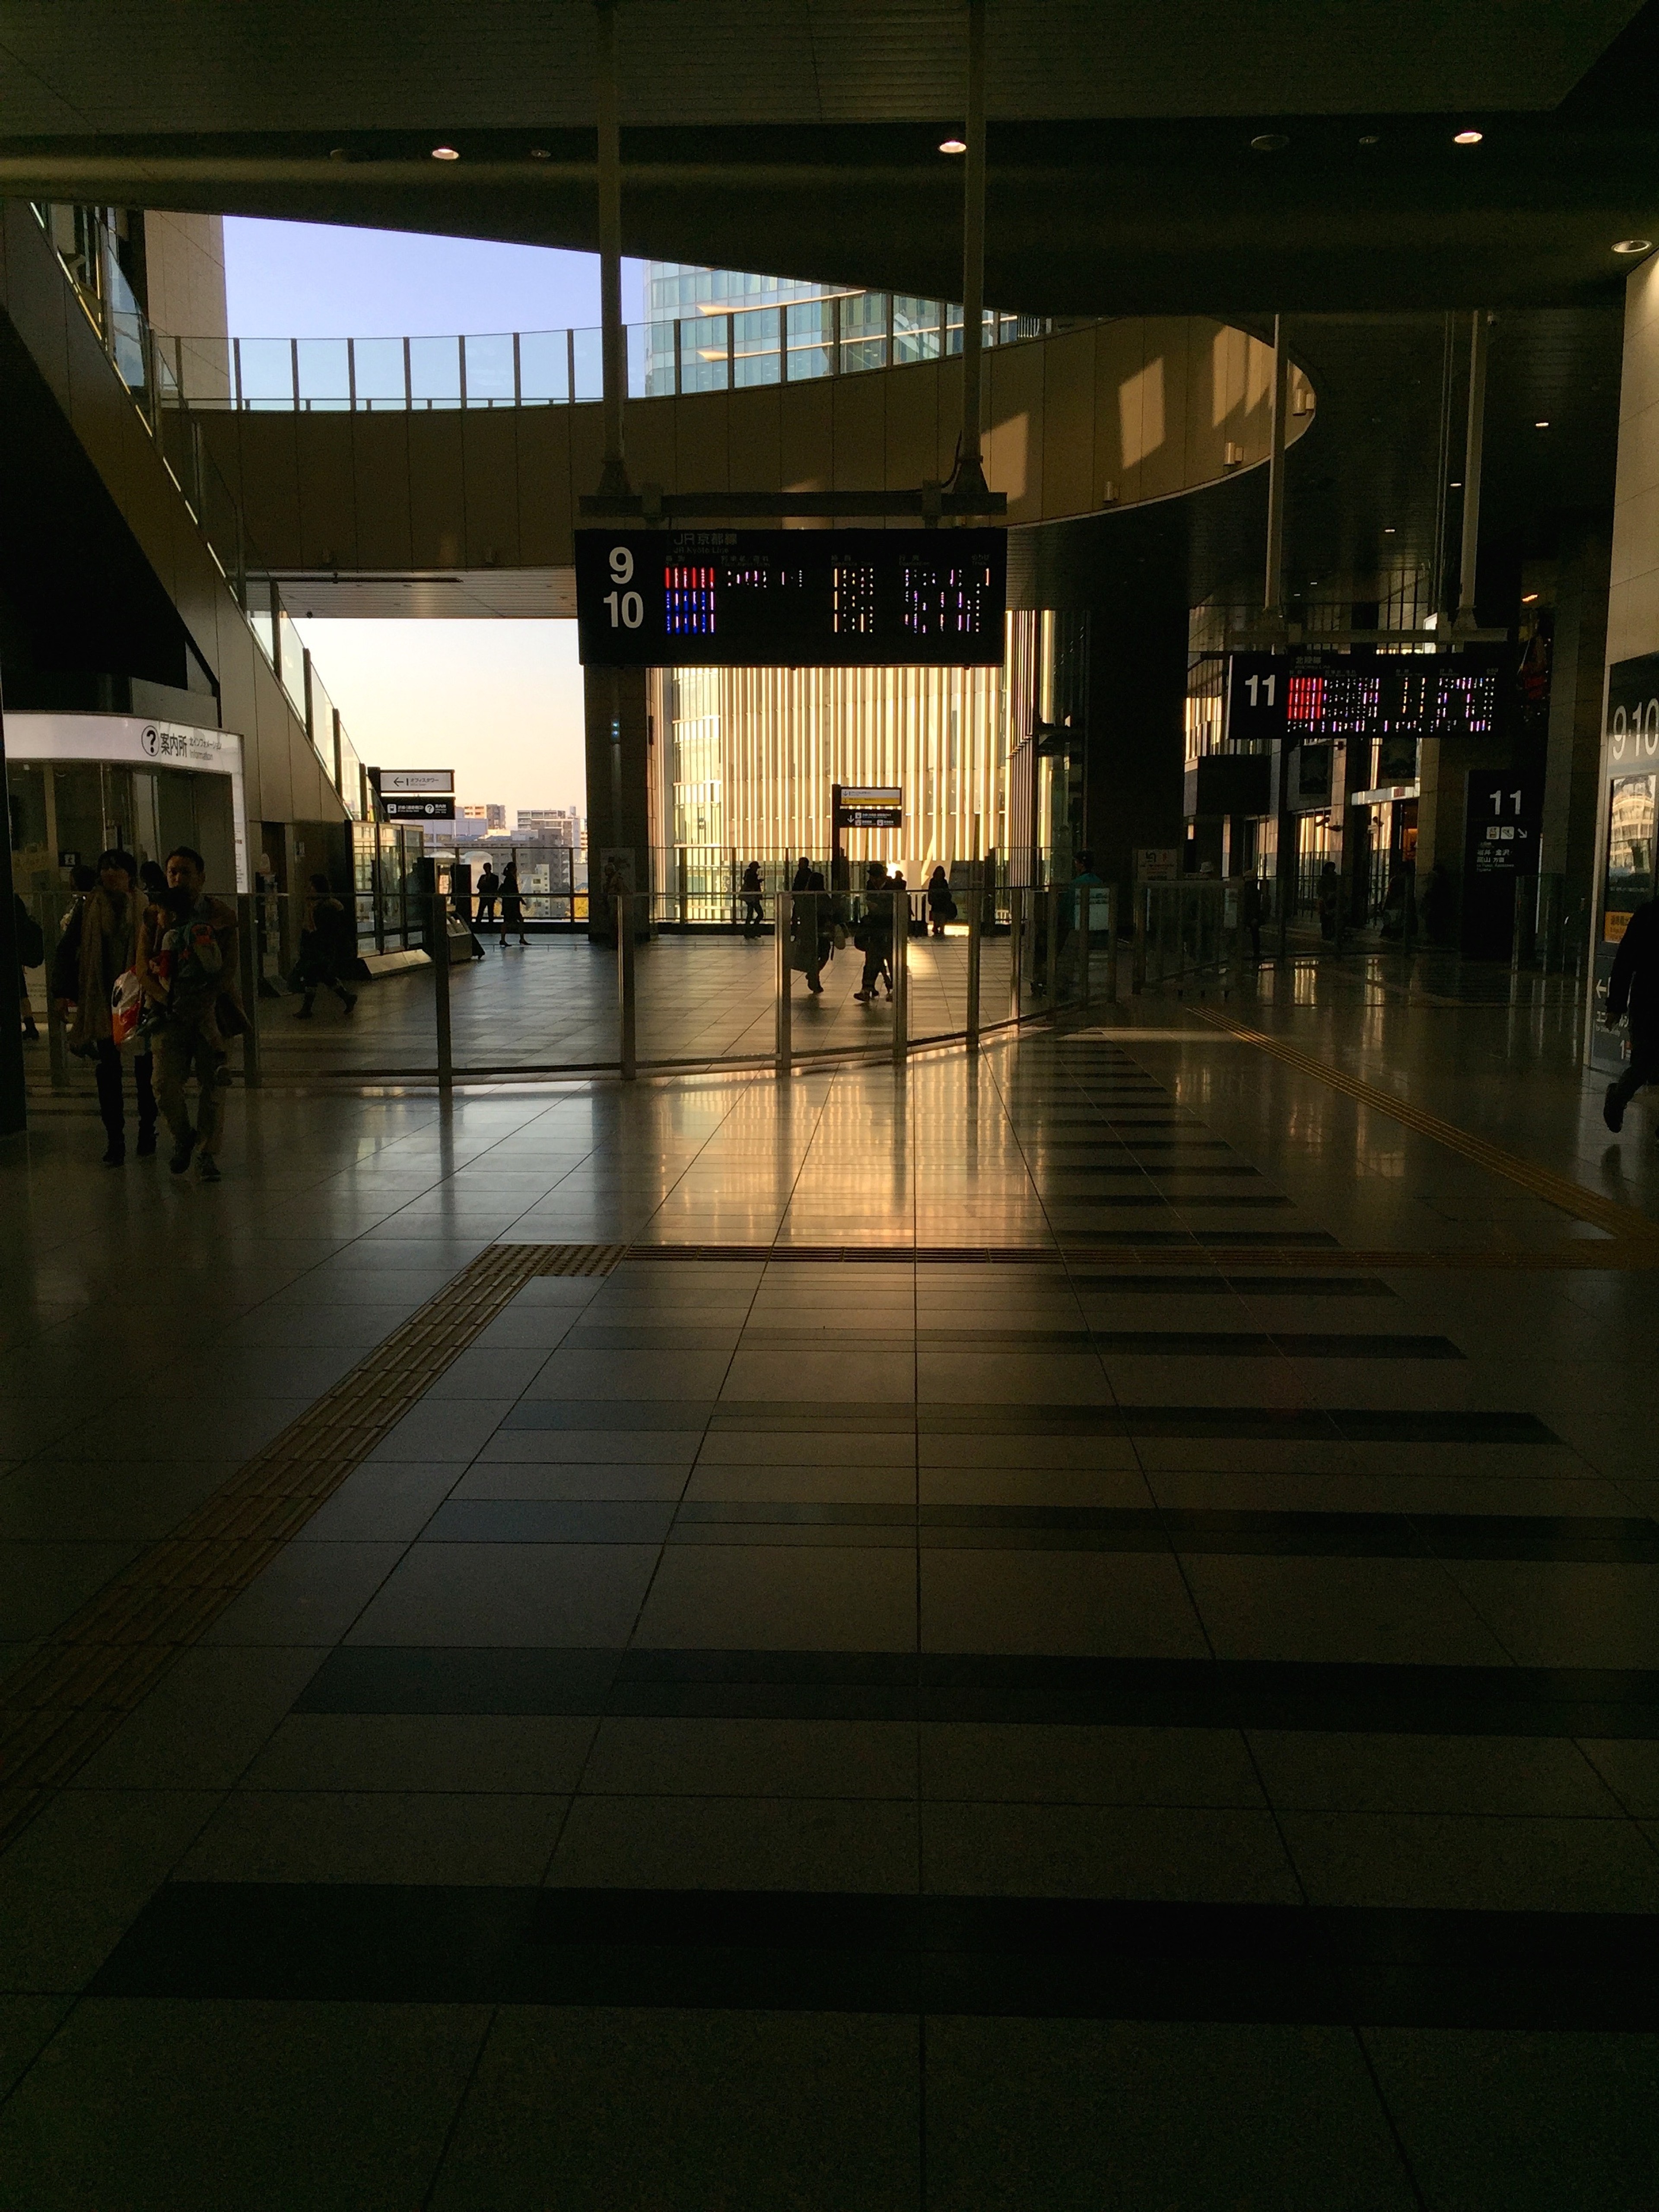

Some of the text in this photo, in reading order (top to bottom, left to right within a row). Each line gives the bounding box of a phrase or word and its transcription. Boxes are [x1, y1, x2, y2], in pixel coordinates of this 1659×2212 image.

[609, 546, 634, 585] 9
[603, 591, 644, 629] 10
[1245, 674, 1276, 706] 11
[160, 733, 188, 757] 案内所
[1489, 790, 1522, 815] 11
